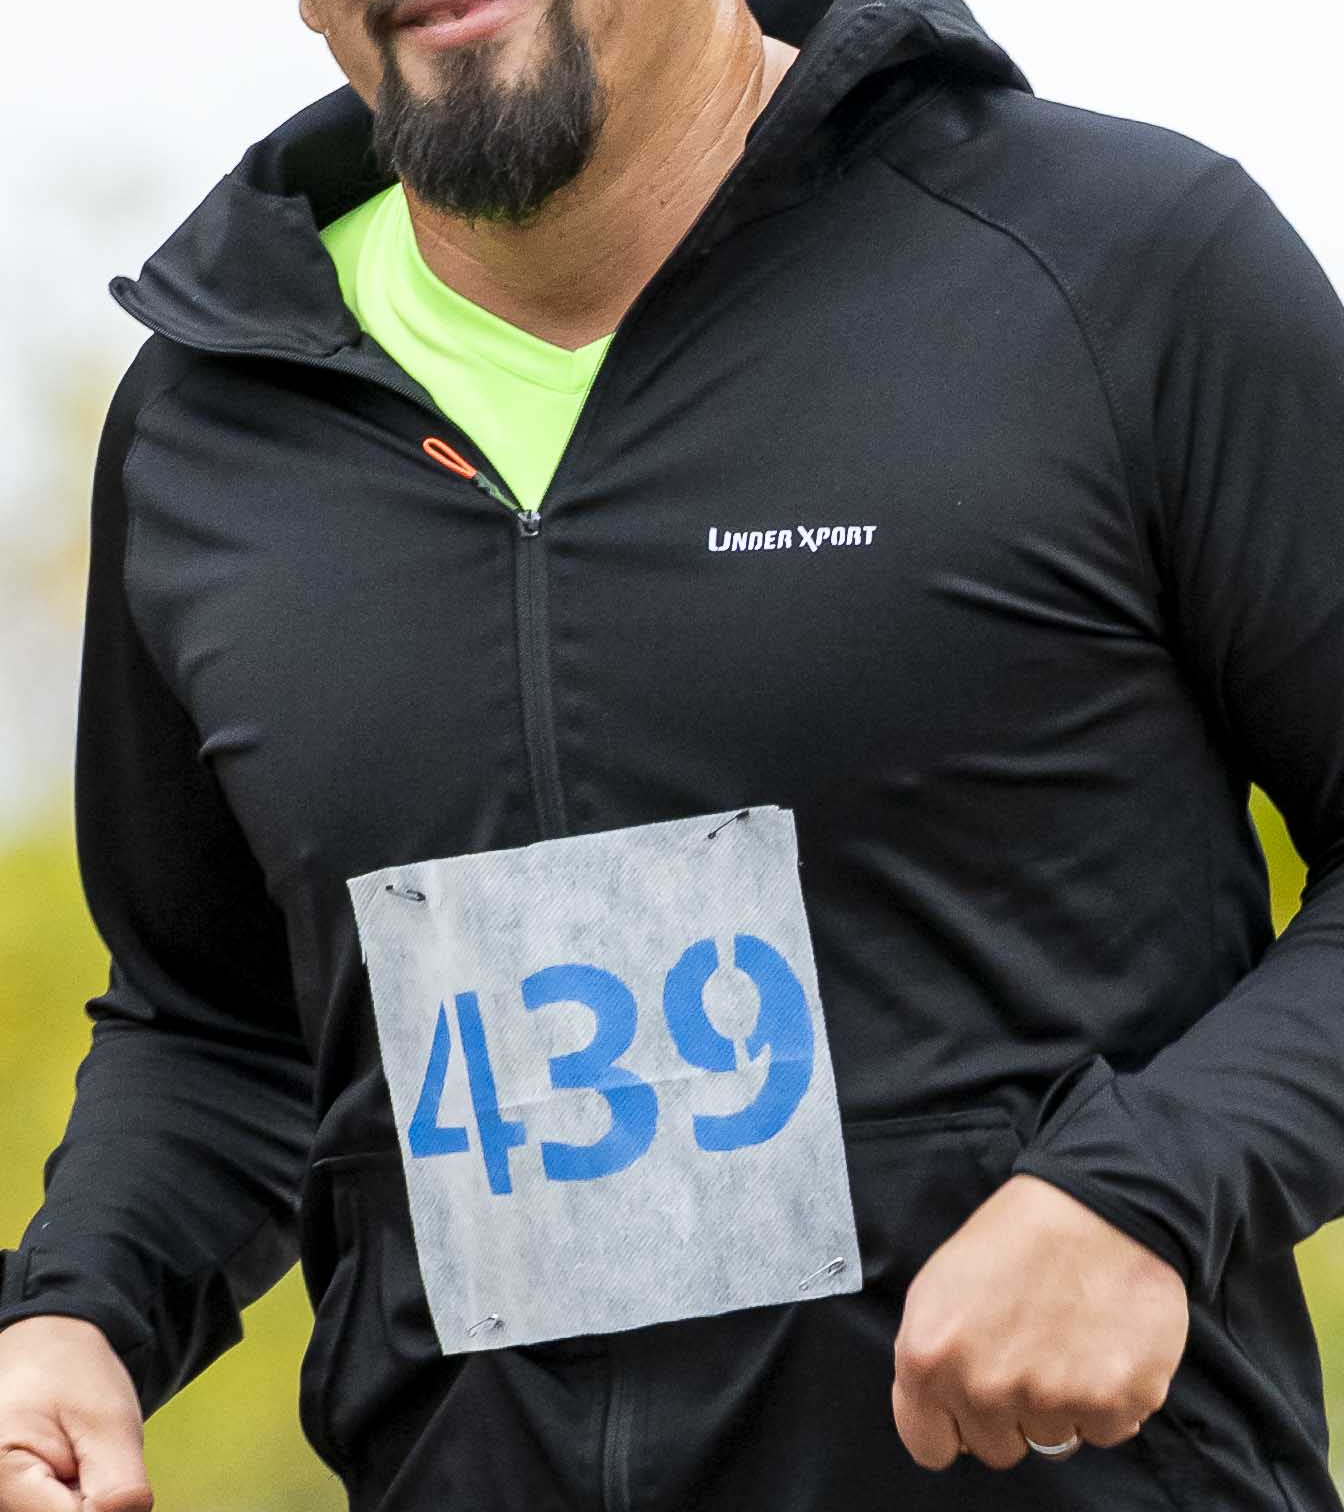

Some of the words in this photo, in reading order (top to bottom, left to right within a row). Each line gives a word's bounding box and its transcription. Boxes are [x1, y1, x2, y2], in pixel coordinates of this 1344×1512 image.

[708, 526, 793, 552] UNDER
[797, 525, 878, 553] XPORT
[407, 934, 815, 1196] 439
